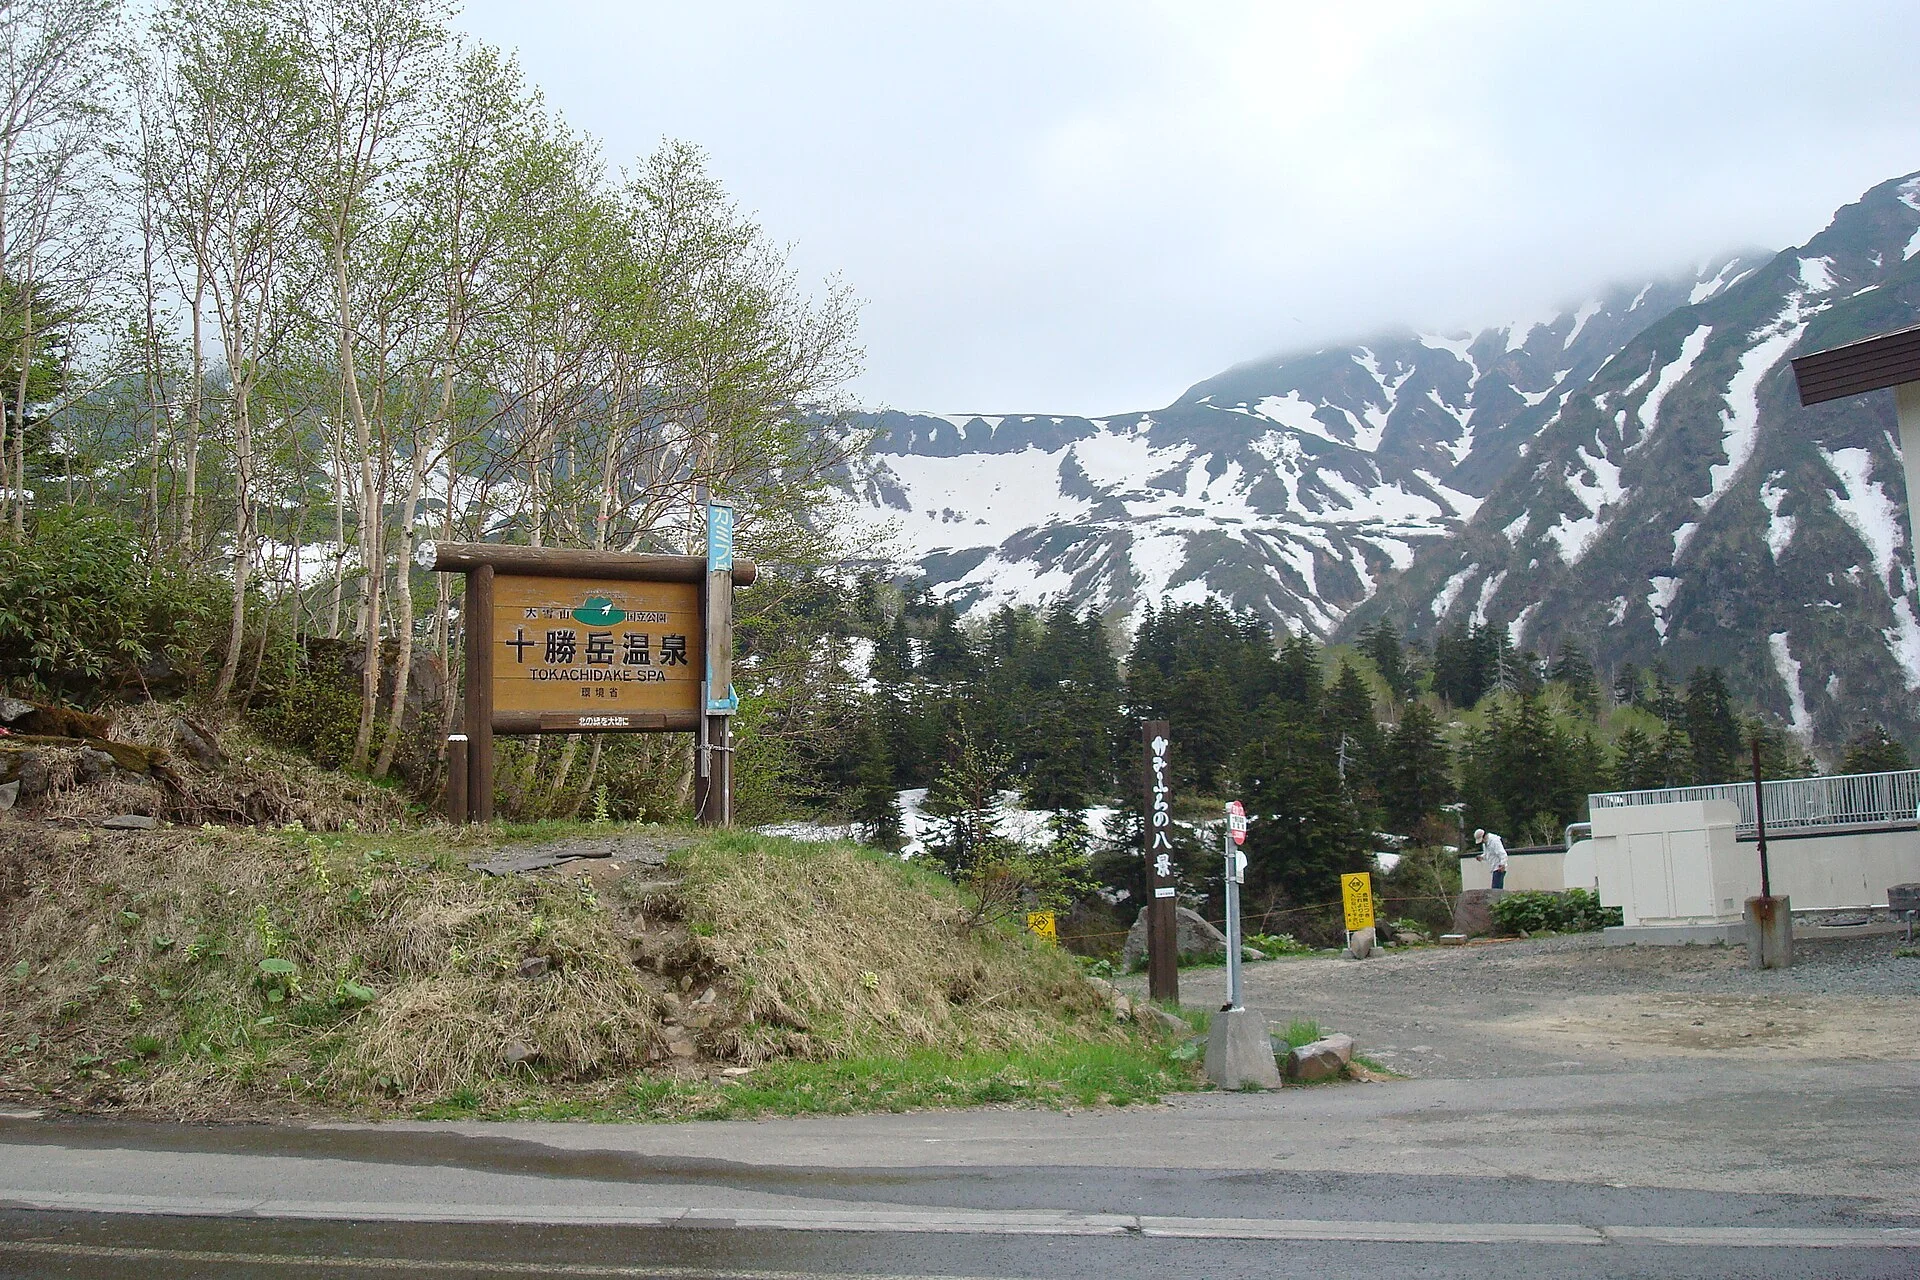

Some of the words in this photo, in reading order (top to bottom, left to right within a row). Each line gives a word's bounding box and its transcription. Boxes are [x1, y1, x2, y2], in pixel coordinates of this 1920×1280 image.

[526, 607, 570, 620] 大雪山
[627, 611, 667, 623] 国立公園
[505, 628, 689, 666] 十勝岳温泉
[530, 668, 632, 682] TOKACHIDAKE
[637, 670, 666, 682] SPA
[581, 687, 618, 698] 環境省
[1151, 735, 1172, 878] かみふらの八景
